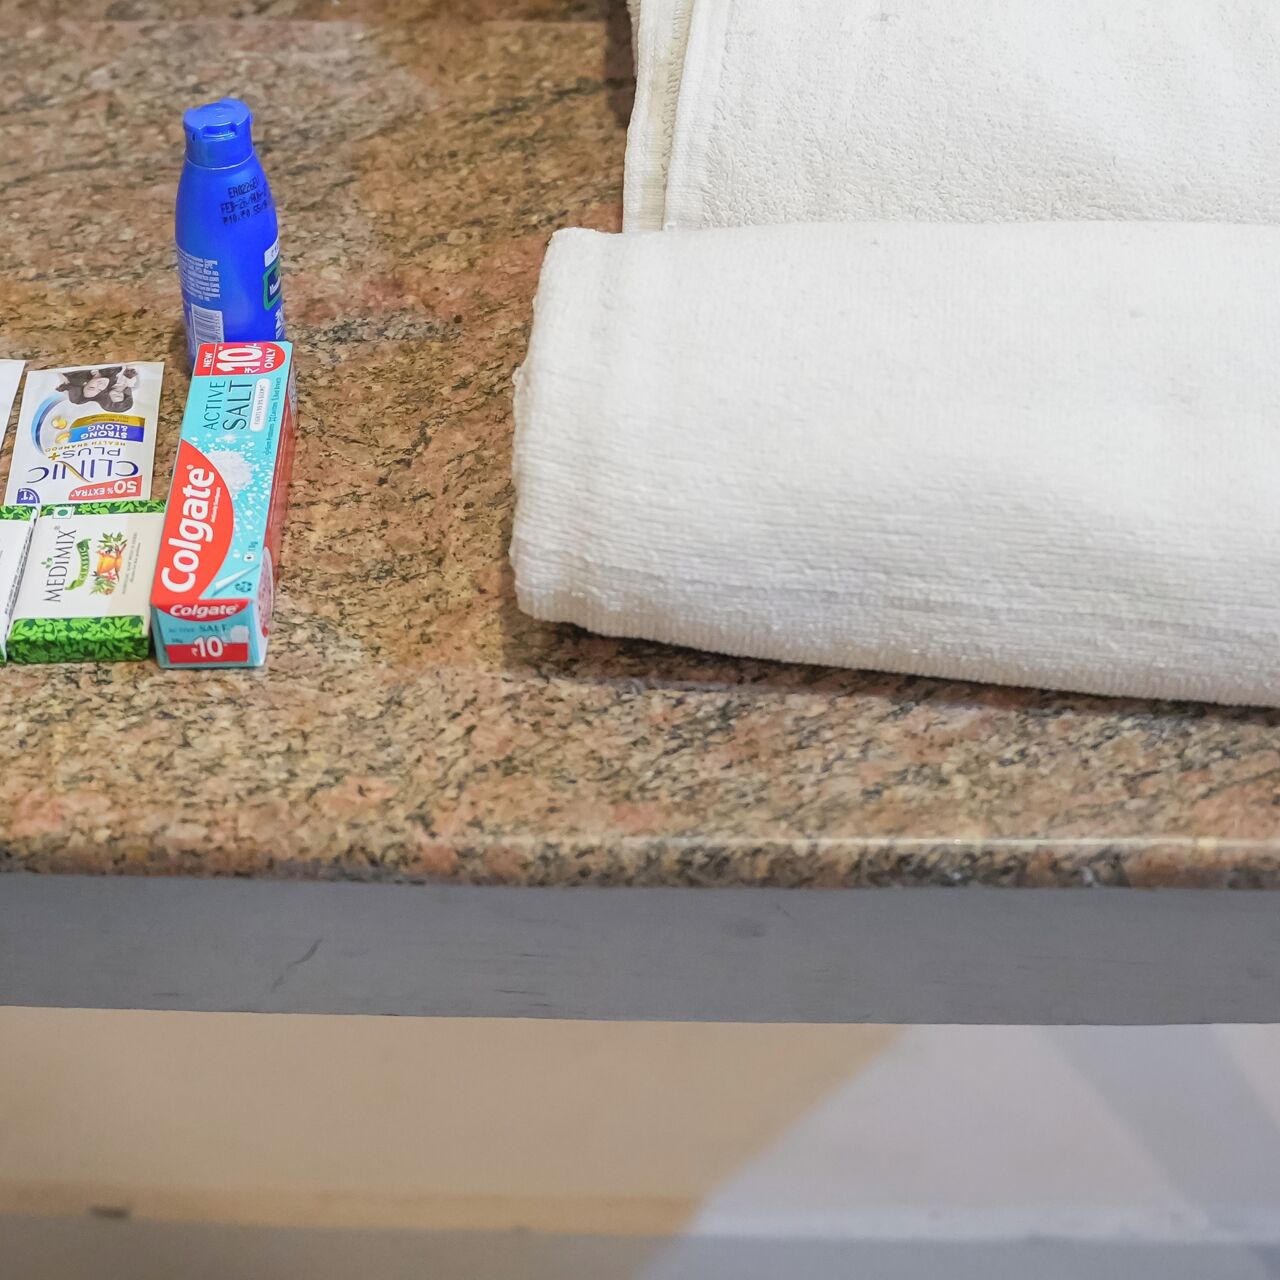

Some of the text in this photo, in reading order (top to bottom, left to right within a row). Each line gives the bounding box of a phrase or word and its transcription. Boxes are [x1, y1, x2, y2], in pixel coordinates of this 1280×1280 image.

[202, 351, 213, 368] NEW
[264, 347, 276, 369] ONLY
[202, 380, 226, 431] ACTIVE
[222, 380, 253, 431] SALT
[80, 432, 128, 440] STRONG
[45, 443, 88, 453] SHAMPOO
[26, 459, 139, 483] CLINIC
[107, 480, 138, 494] 50%
[161, 465, 215, 593] Colgate
[42, 529, 77, 603] MEDIMIX
[170, 604, 240, 619] Colgate
